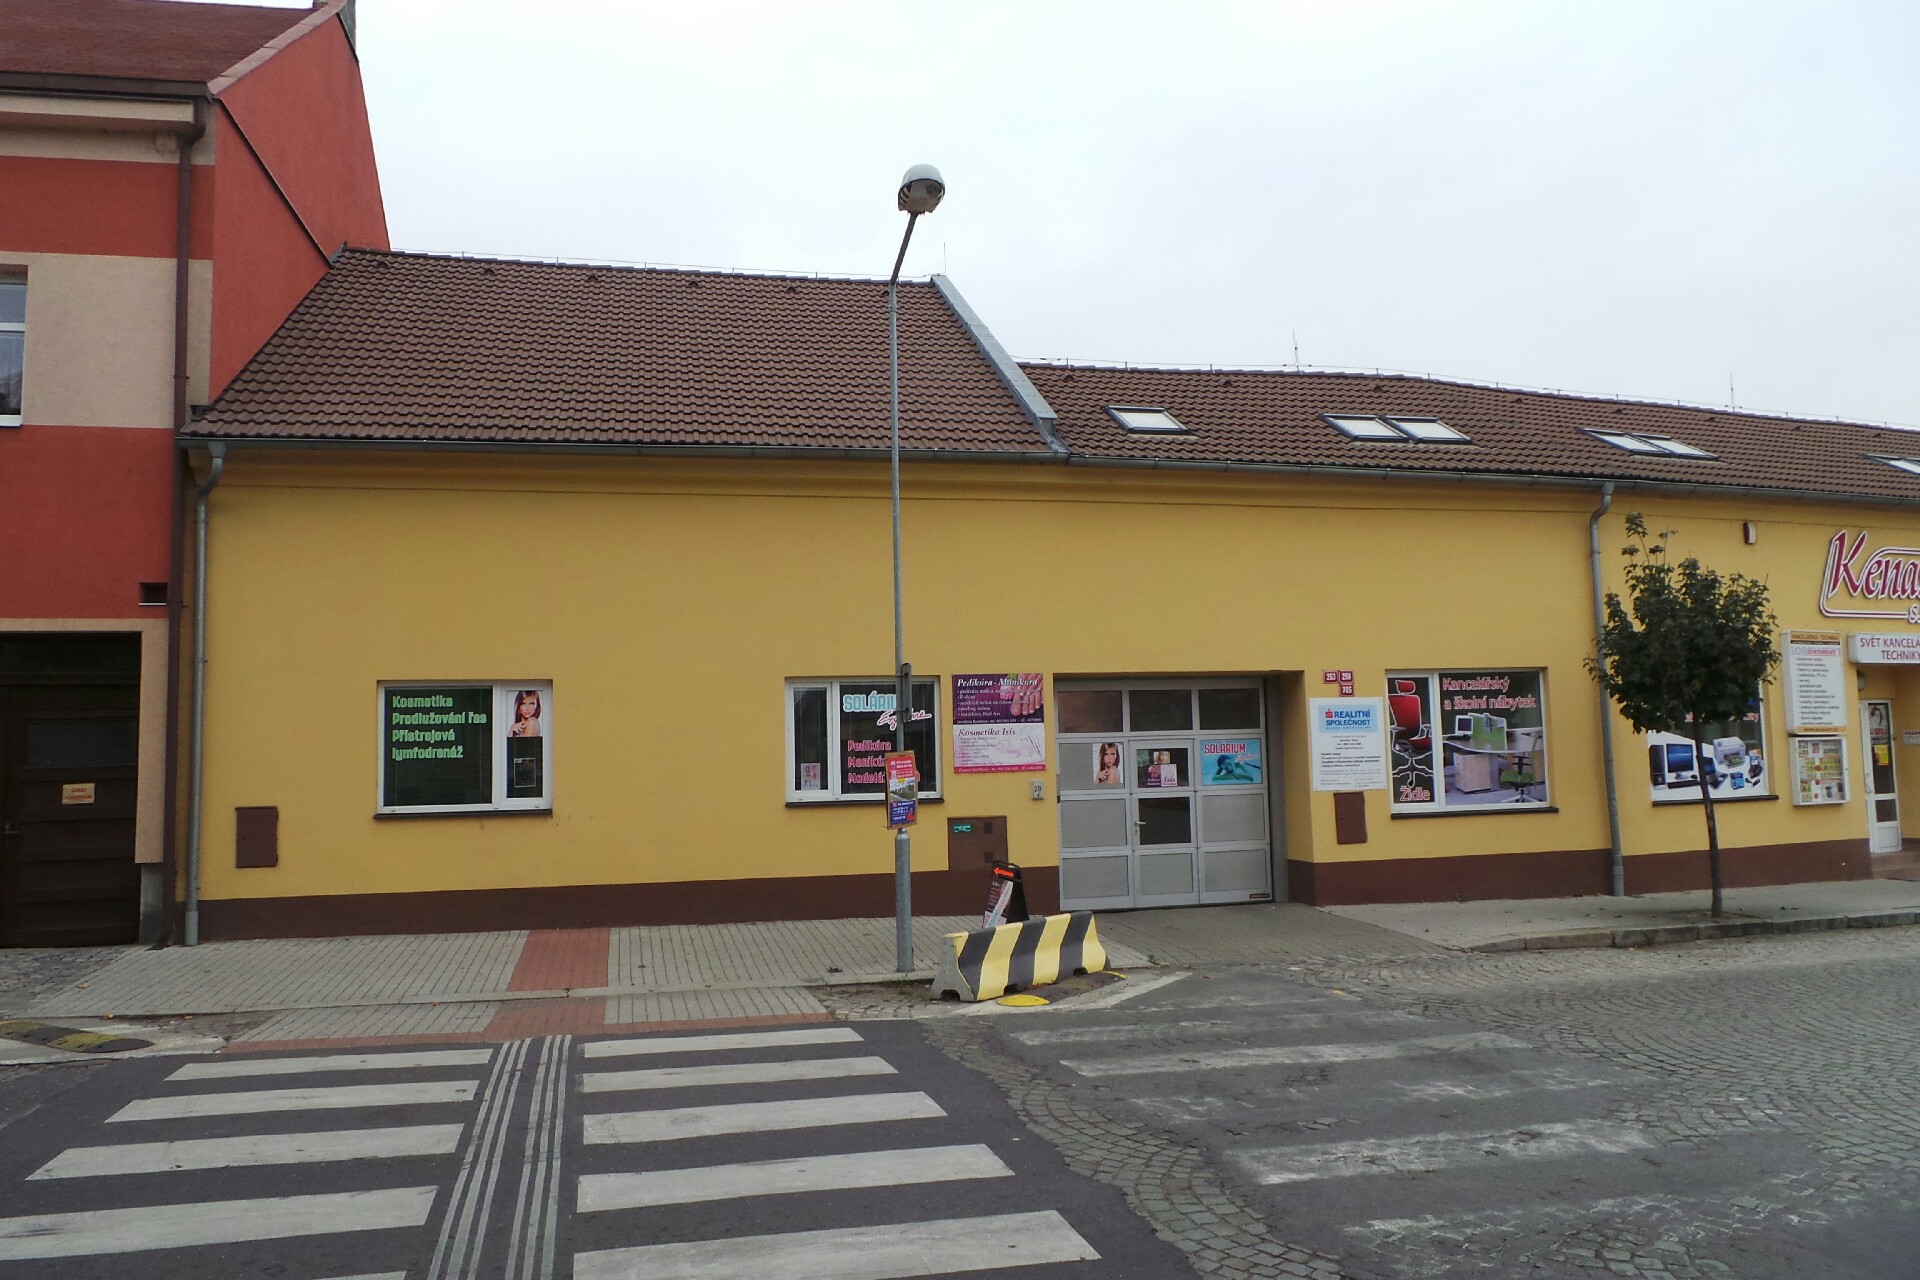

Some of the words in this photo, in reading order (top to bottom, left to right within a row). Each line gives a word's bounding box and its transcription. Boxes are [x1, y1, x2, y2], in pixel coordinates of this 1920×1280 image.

[1860, 635, 1880, 648] SVĚT
[957, 678, 993, 687] Pedikúra
[1442, 676, 1510, 693] Kancelářský
[392, 694, 453, 708] Kosmetika
[843, 690, 897, 712] SOLÁRIU
[1444, 700, 1451, 710] a
[1454, 696, 1487, 710] školní
[1489, 694, 1537, 711] nábytek
[392, 711, 466, 725] Prodlužování
[468, 711, 487, 724] řas
[1334, 709, 1370, 718] REALITNÍ
[1326, 717, 1370, 726] SPOLEČNOST
[392, 728, 455, 744] Přístrojová
[958, 728, 1000, 736] Kosmetika
[1002, 727, 1016, 736] Isis
[847, 739, 892, 751] Pedikúra
[1204, 743, 1247, 754] SOLARIUM
[391, 745, 464, 761] lymfodrenáž
[847, 771, 885, 784] Modelá
[1400, 786, 1431, 801] Židle
